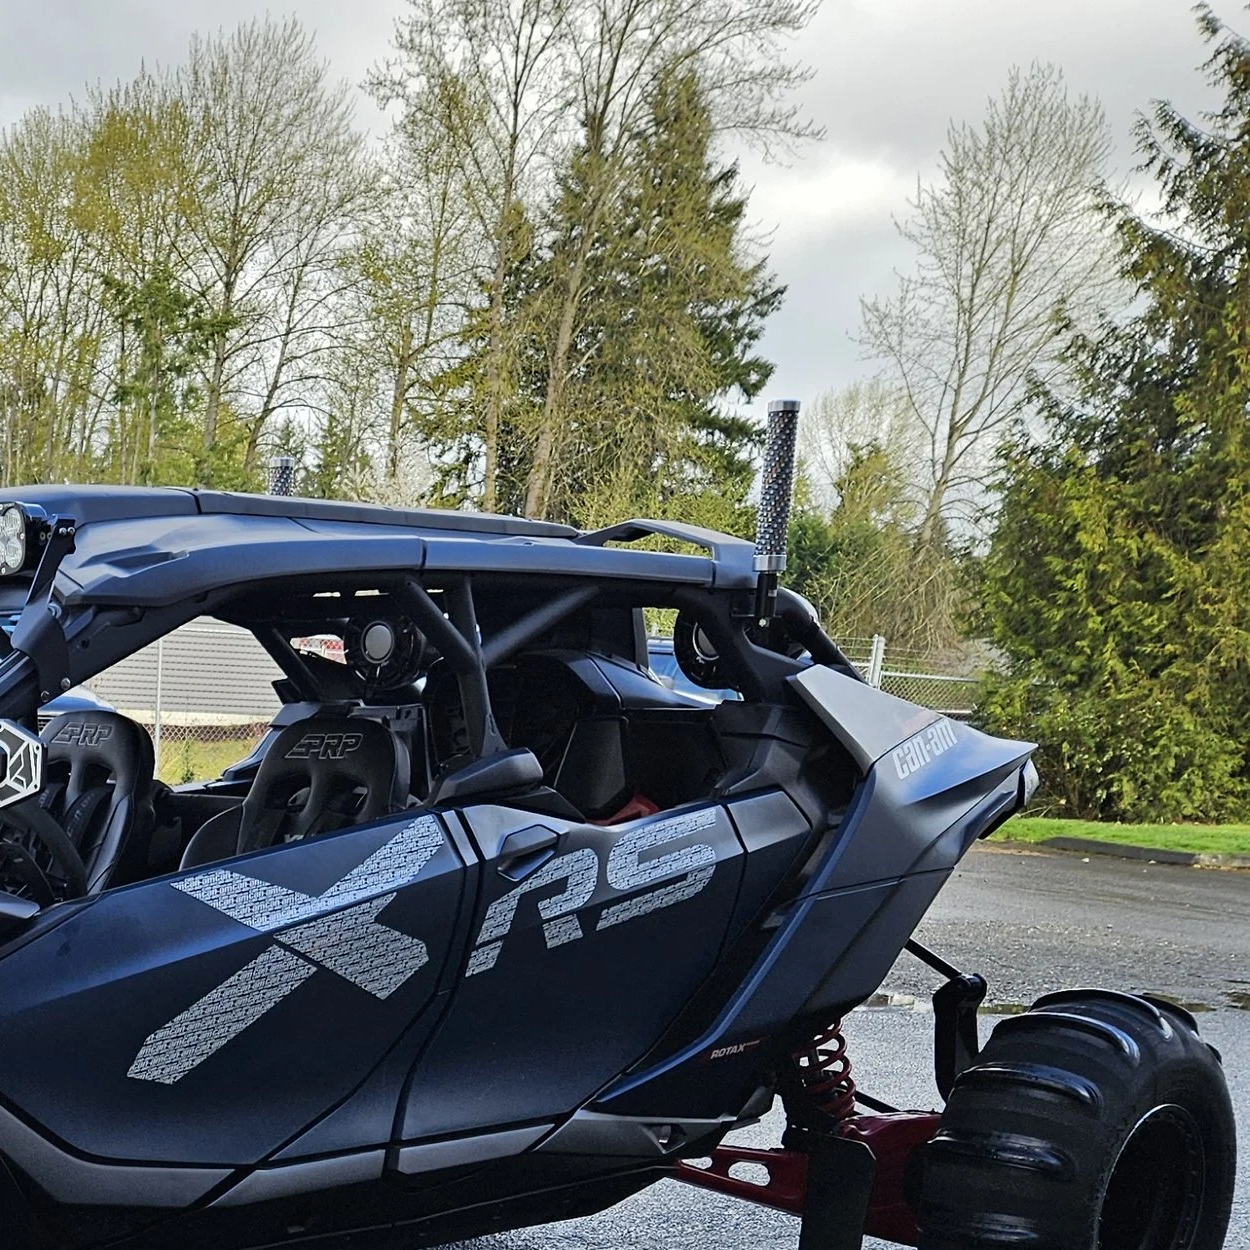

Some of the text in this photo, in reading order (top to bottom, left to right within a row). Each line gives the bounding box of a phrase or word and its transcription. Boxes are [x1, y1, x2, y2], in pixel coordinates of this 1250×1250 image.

[51, 721, 115, 746] PRP
[285, 733, 364, 760] PRP
[710, 1043, 747, 1060] ROTAX
